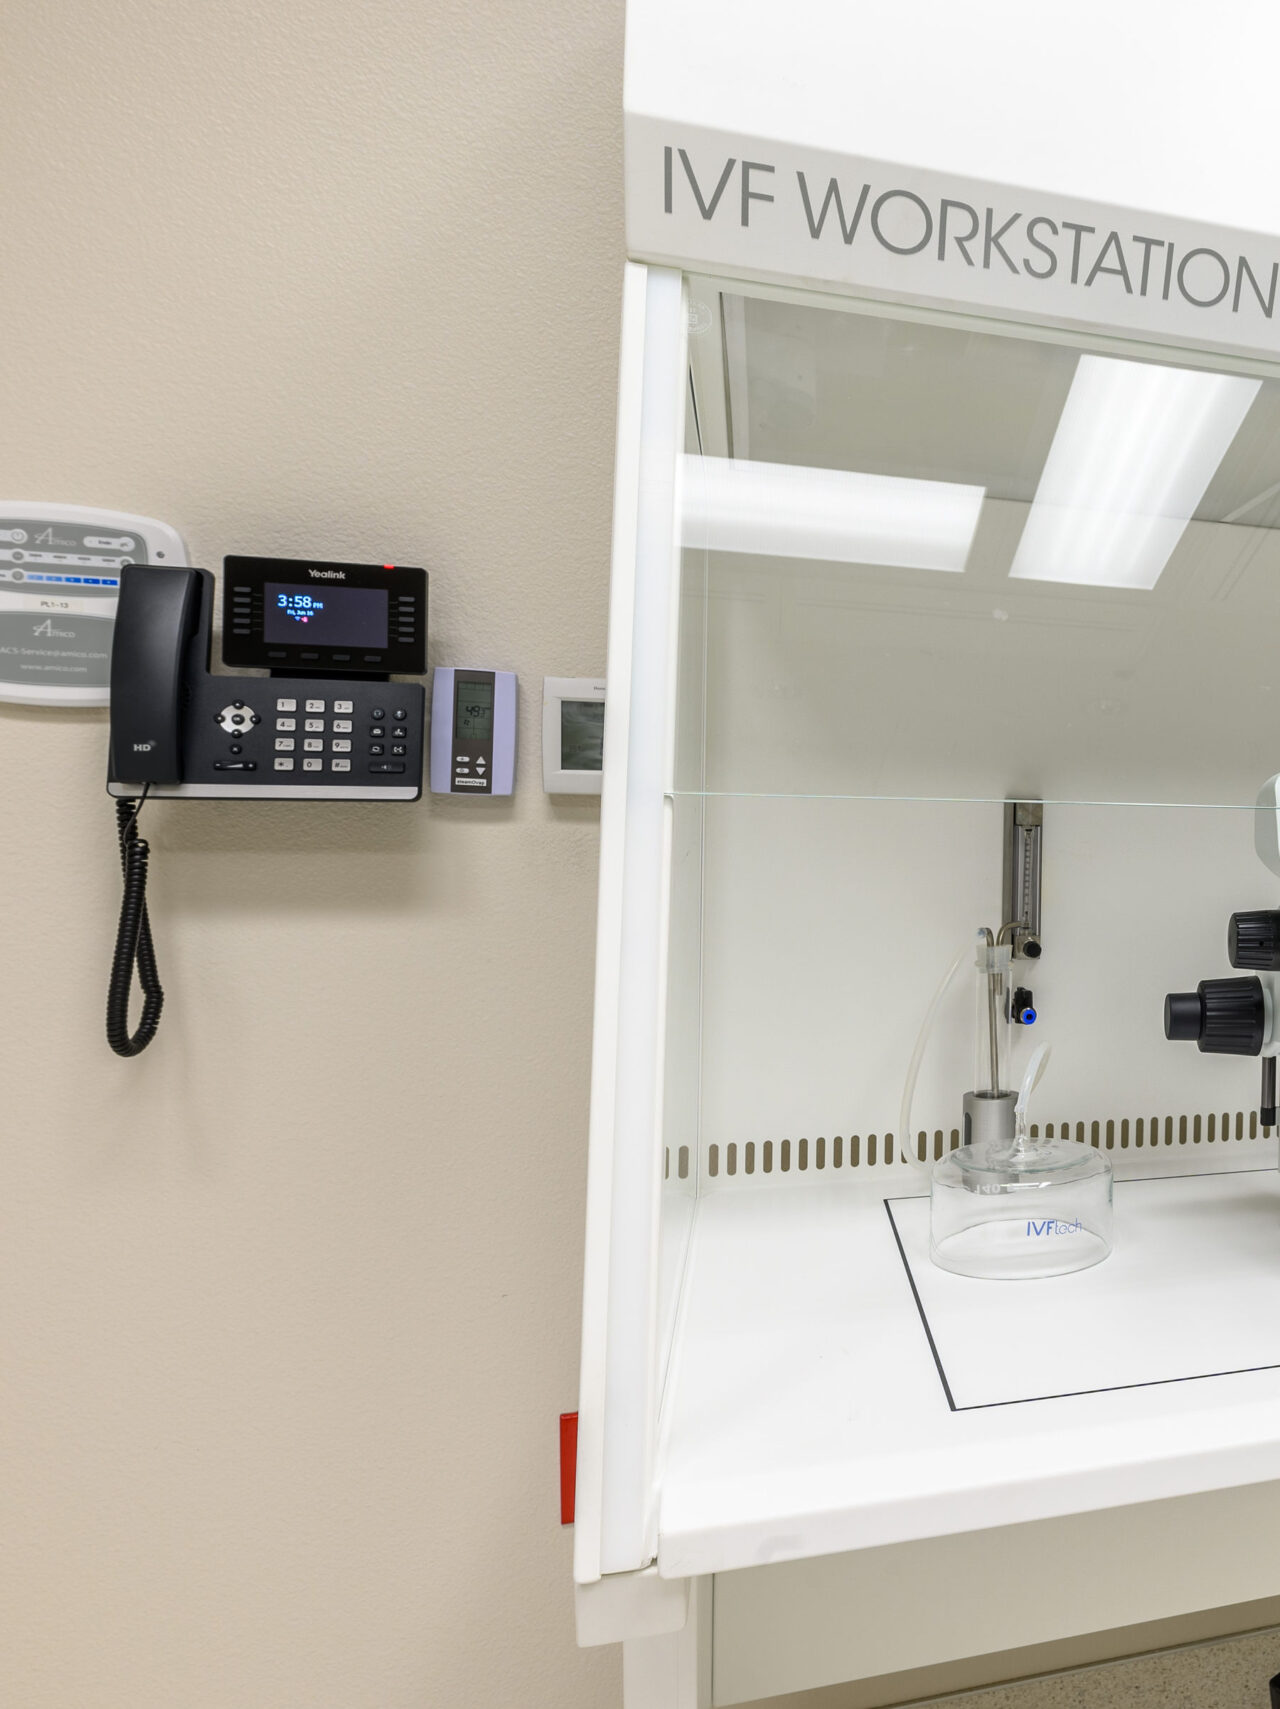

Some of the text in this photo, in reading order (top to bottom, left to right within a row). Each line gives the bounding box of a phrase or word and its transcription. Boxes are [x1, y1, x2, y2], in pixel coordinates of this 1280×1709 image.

[663, 145, 1279, 319] IVF WORKSTATION
[308, 569, 346, 580] Yealink
[277, 594, 312, 608] 3:58
[133, 744, 151, 752] HD
[1026, 1218, 1083, 1237] IVFtech
